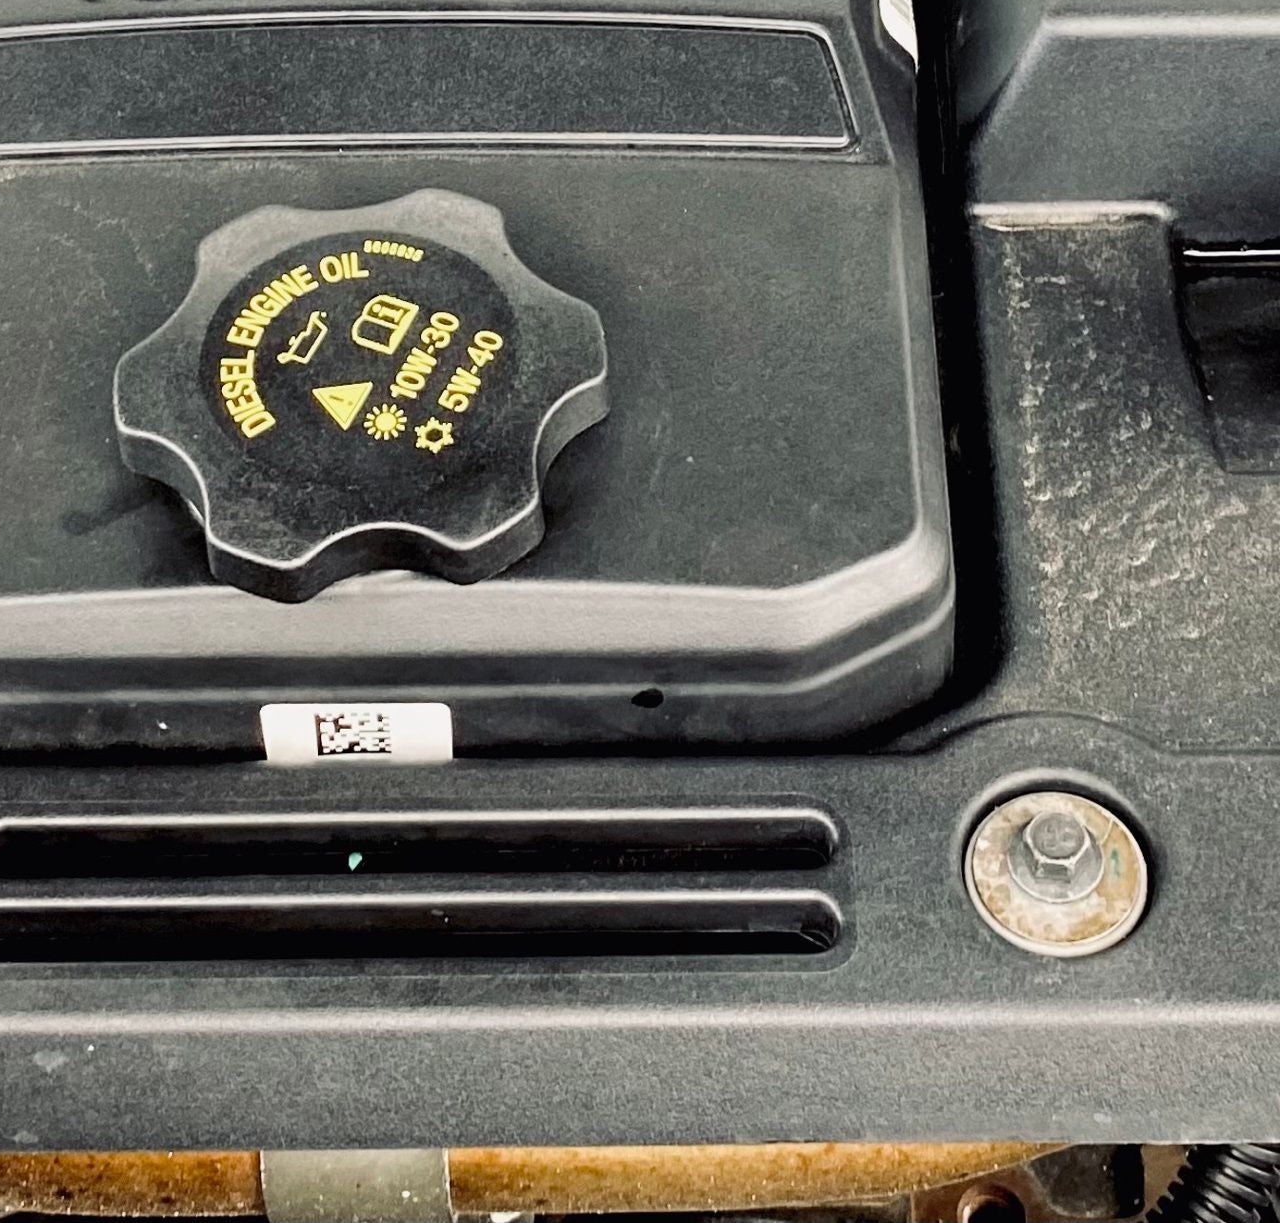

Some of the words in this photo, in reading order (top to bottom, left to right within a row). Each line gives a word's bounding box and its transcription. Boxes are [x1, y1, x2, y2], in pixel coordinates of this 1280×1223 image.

[226, 263, 320, 348] ENGINE
[318, 250, 371, 284] OIL
[220, 348, 277, 440] DIESEL
[389, 310, 462, 400] 10W-30
[438, 328, 504, 414] 5W-40
